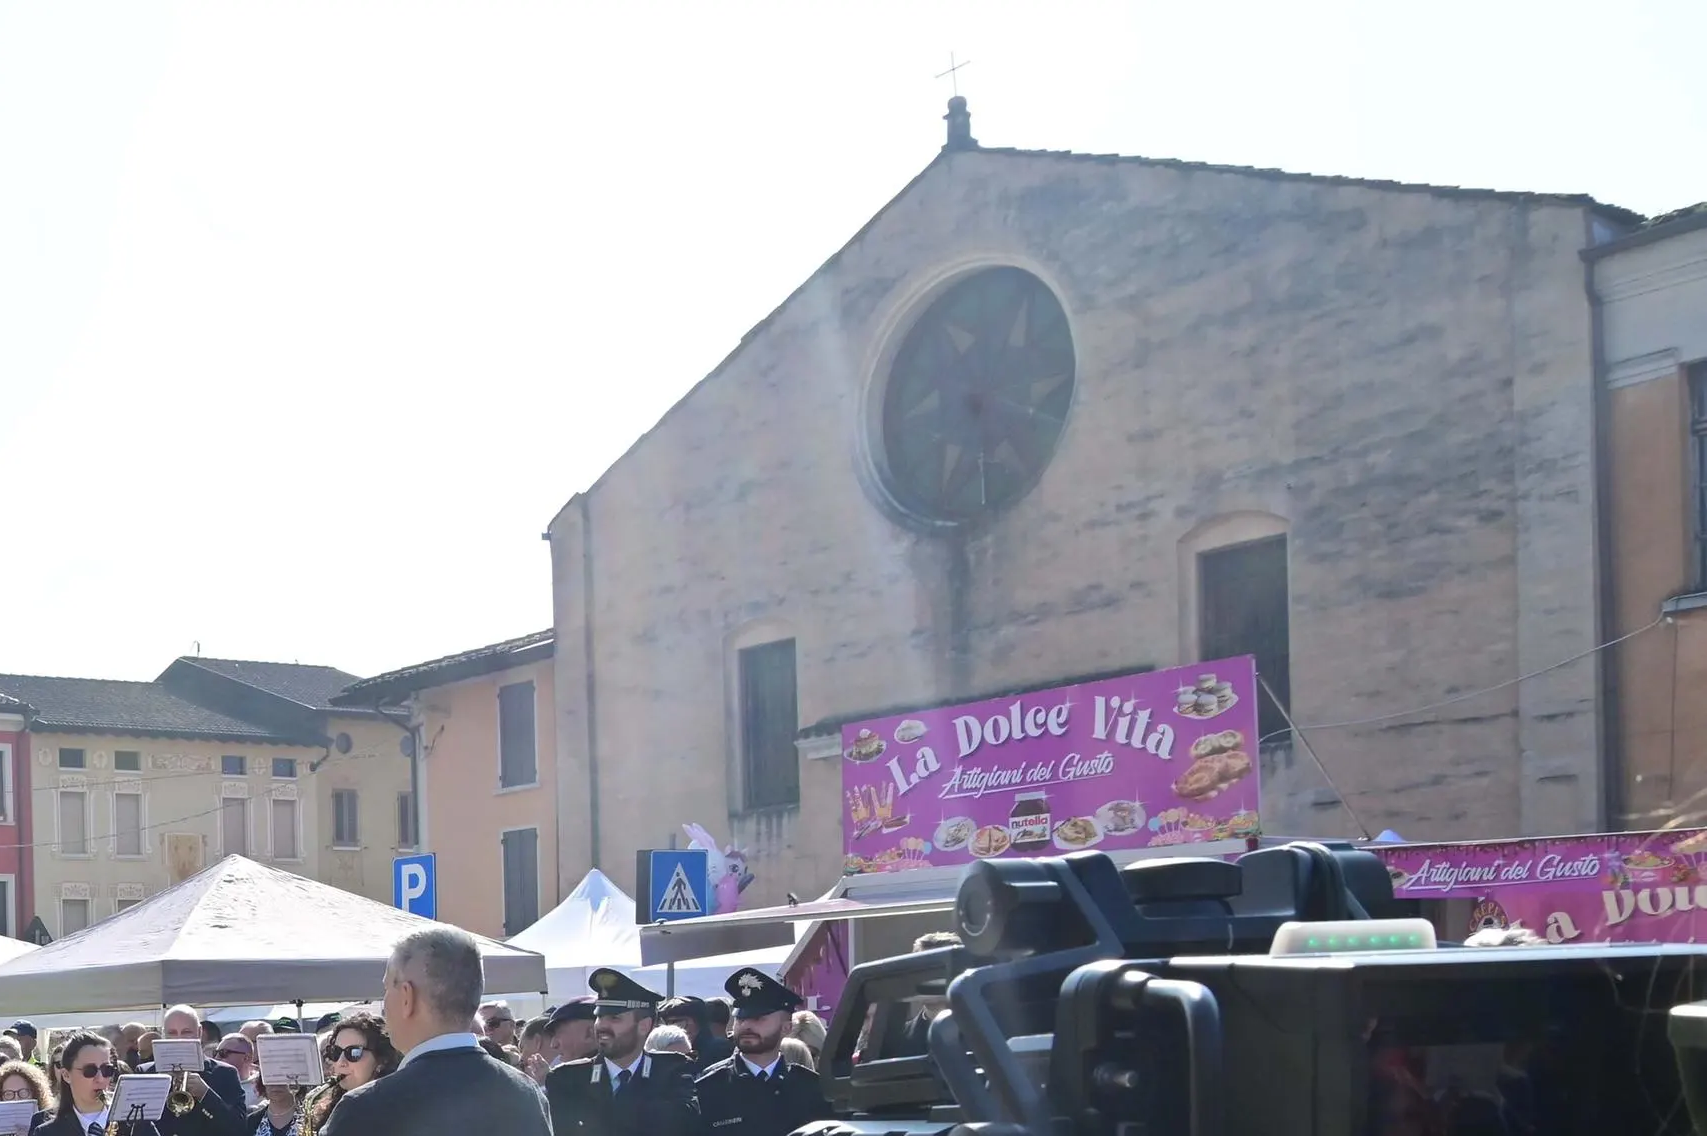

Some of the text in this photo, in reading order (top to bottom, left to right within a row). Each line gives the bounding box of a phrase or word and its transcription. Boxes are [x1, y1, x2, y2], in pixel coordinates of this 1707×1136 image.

[885, 695, 1175, 796] La Dolce Vita
[938, 750, 1115, 799] Artigiani del Gusto
[1011, 815, 1049, 829] nutella
[402, 863, 426, 912] P
[1404, 852, 1601, 892] Artigiani del Gusto
